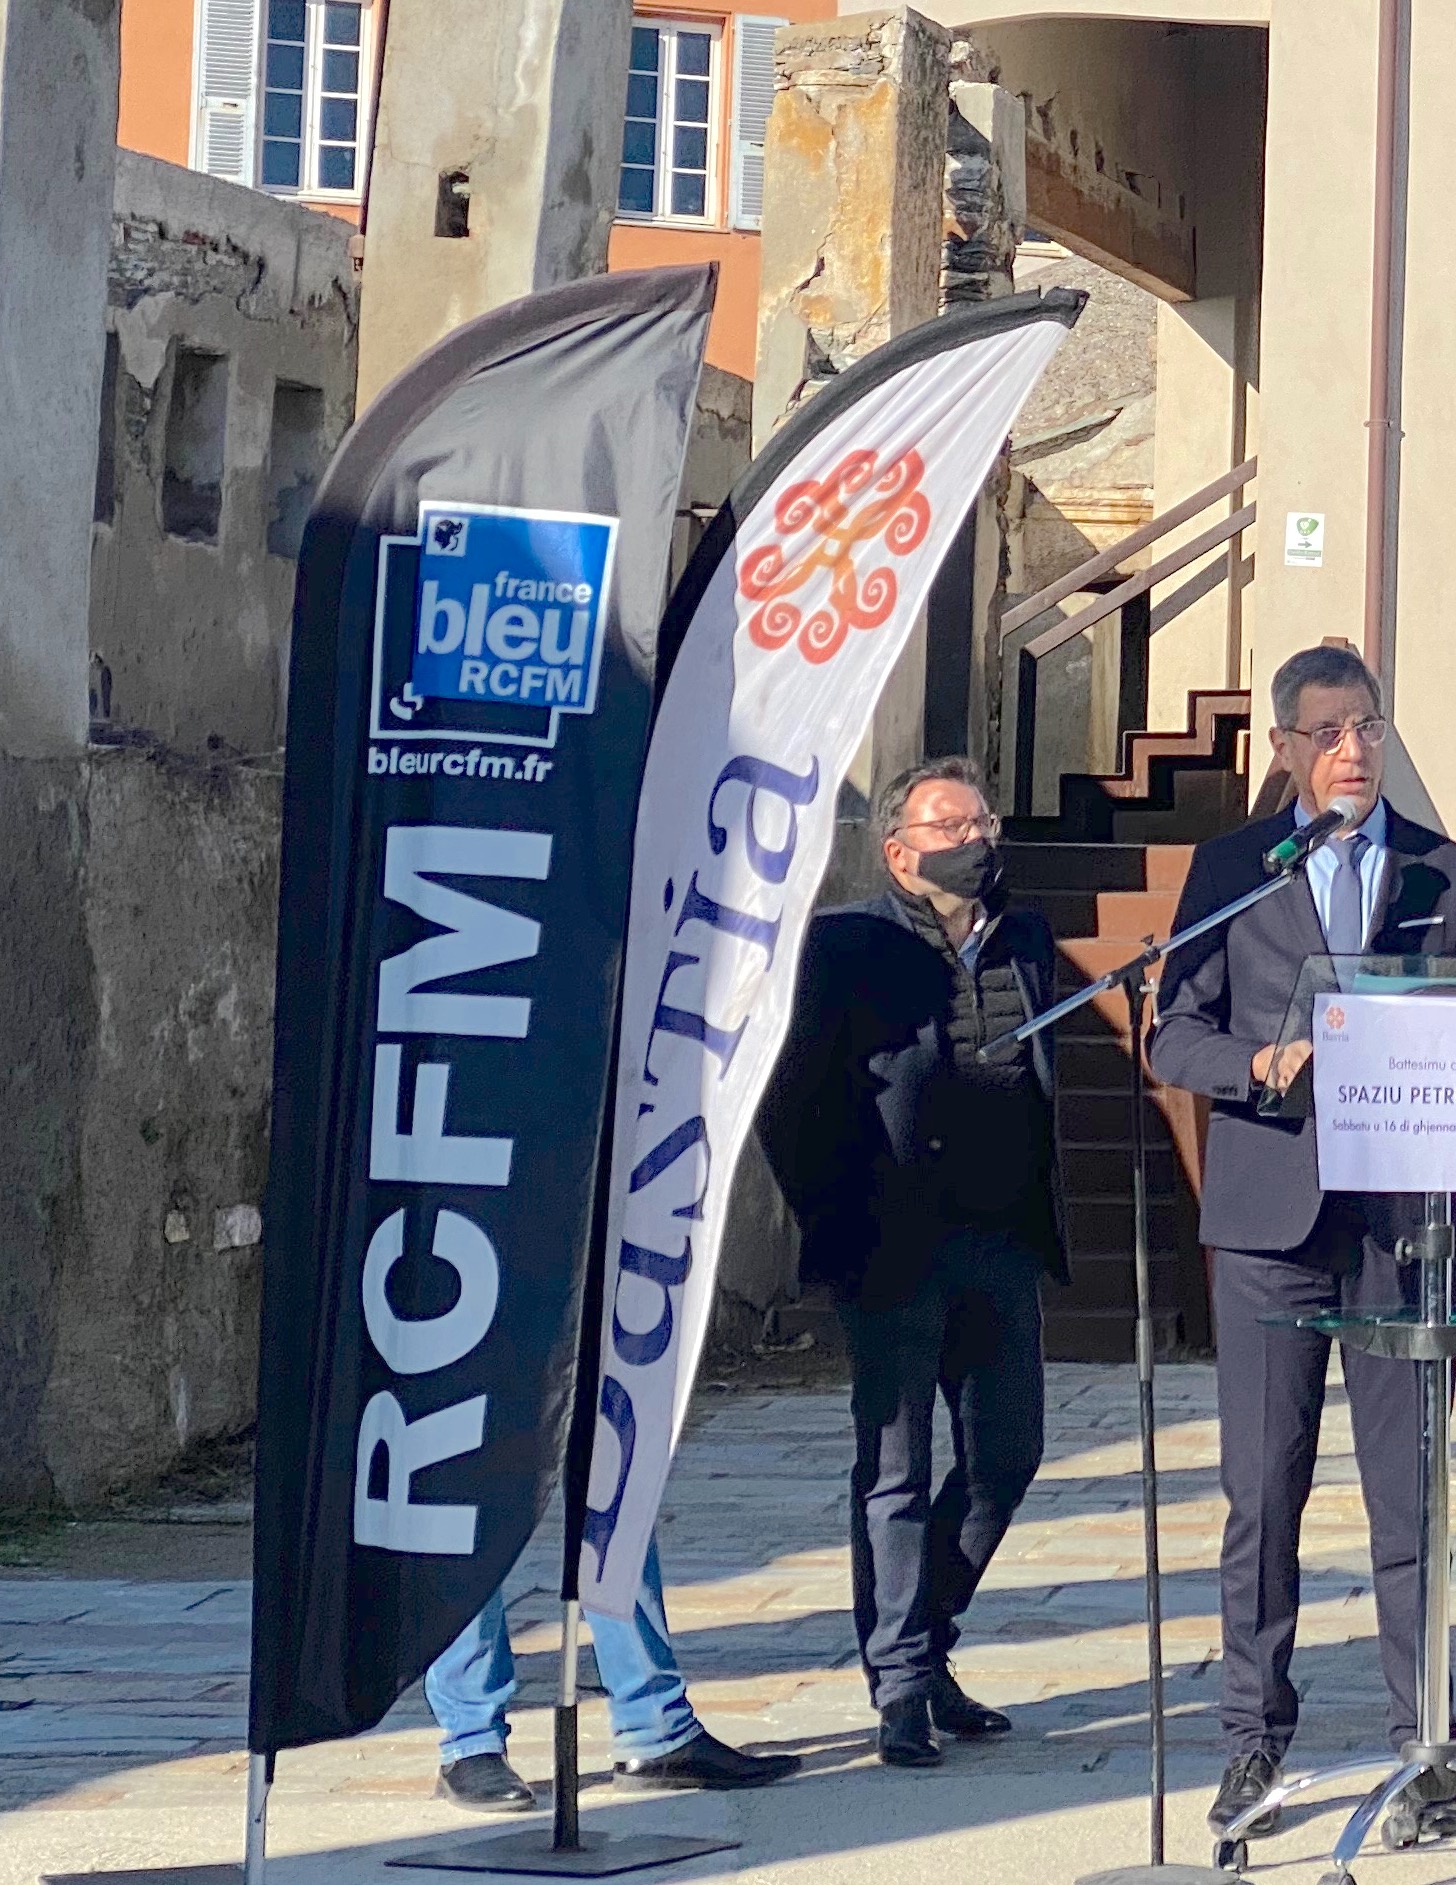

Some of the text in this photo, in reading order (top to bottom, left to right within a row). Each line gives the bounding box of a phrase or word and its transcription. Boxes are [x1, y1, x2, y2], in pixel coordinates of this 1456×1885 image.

[495, 570, 593, 604] france
[417, 579, 590, 666] bleu
[458, 659, 583, 702] RCFM
[367, 747, 554, 782] bleurcfm.fr
[1388, 1056, 1446, 1071] Battesimu
[1338, 1085, 1401, 1104] SPAZIU
[1373, 1123, 1380, 1132] u
[1384, 1120, 1396, 1132] 16
[1401, 1119, 1410, 1132] di
[354, 825, 553, 1555] RCFM
